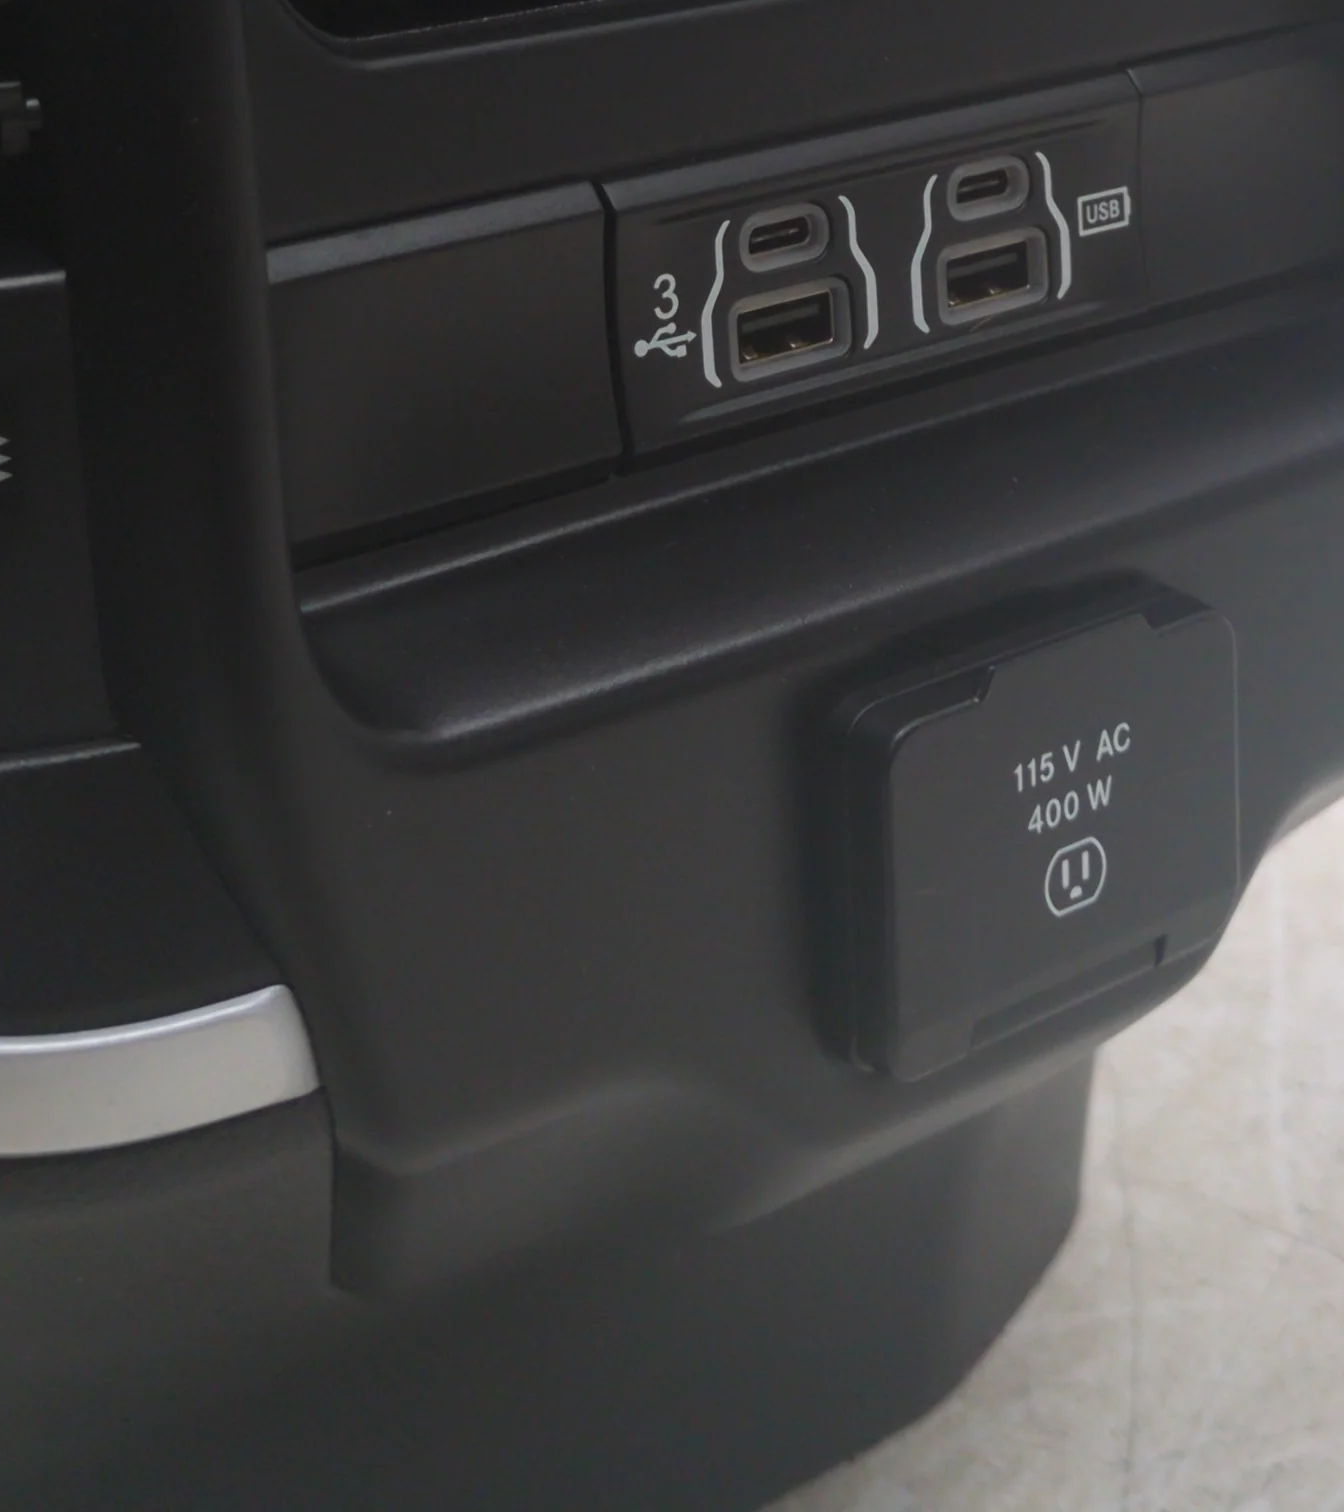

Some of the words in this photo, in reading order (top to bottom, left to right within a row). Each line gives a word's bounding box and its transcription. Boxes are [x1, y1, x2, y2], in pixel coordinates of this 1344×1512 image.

[1086, 199, 1121, 224] USB
[654, 273, 679, 320] 3
[1013, 752, 1055, 793] 115
[1062, 739, 1081, 773] V
[1096, 722, 1131, 762] AC
[1027, 791, 1080, 834] 400
[1086, 774, 1113, 811] W
